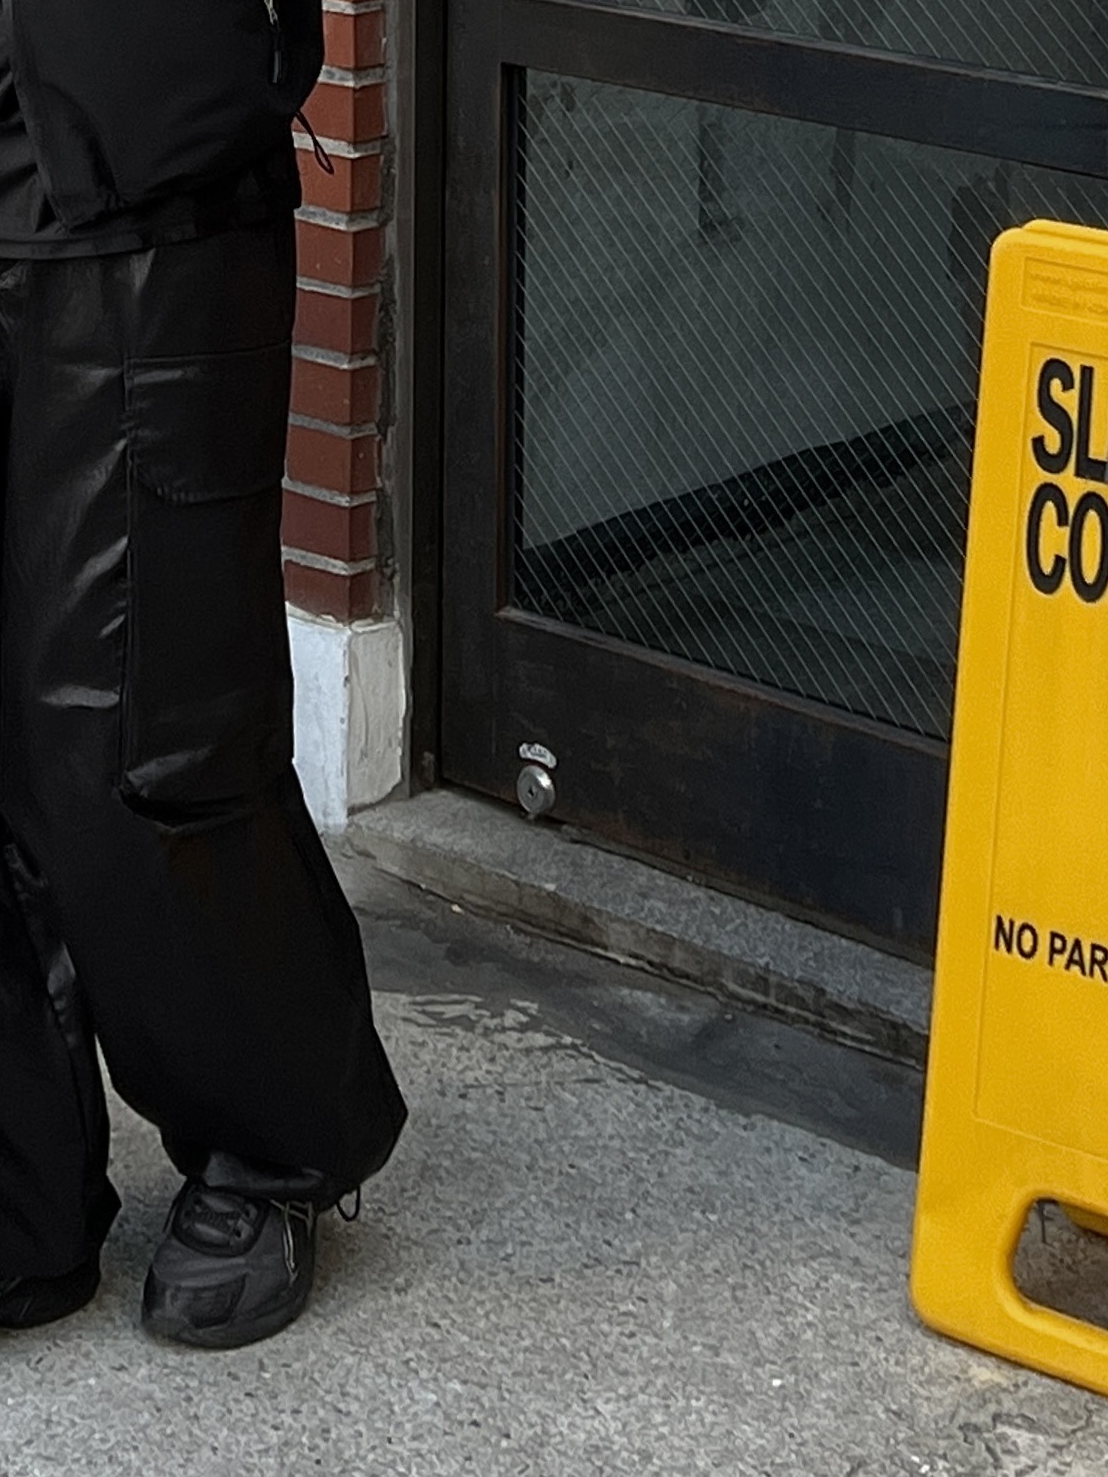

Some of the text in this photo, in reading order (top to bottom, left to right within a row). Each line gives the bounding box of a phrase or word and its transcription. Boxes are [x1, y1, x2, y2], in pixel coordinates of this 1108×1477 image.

[1031, 357, 1108, 484] SL
[1026, 482, 1108, 604] CO
[994, 914, 1108, 984] NO PAR
